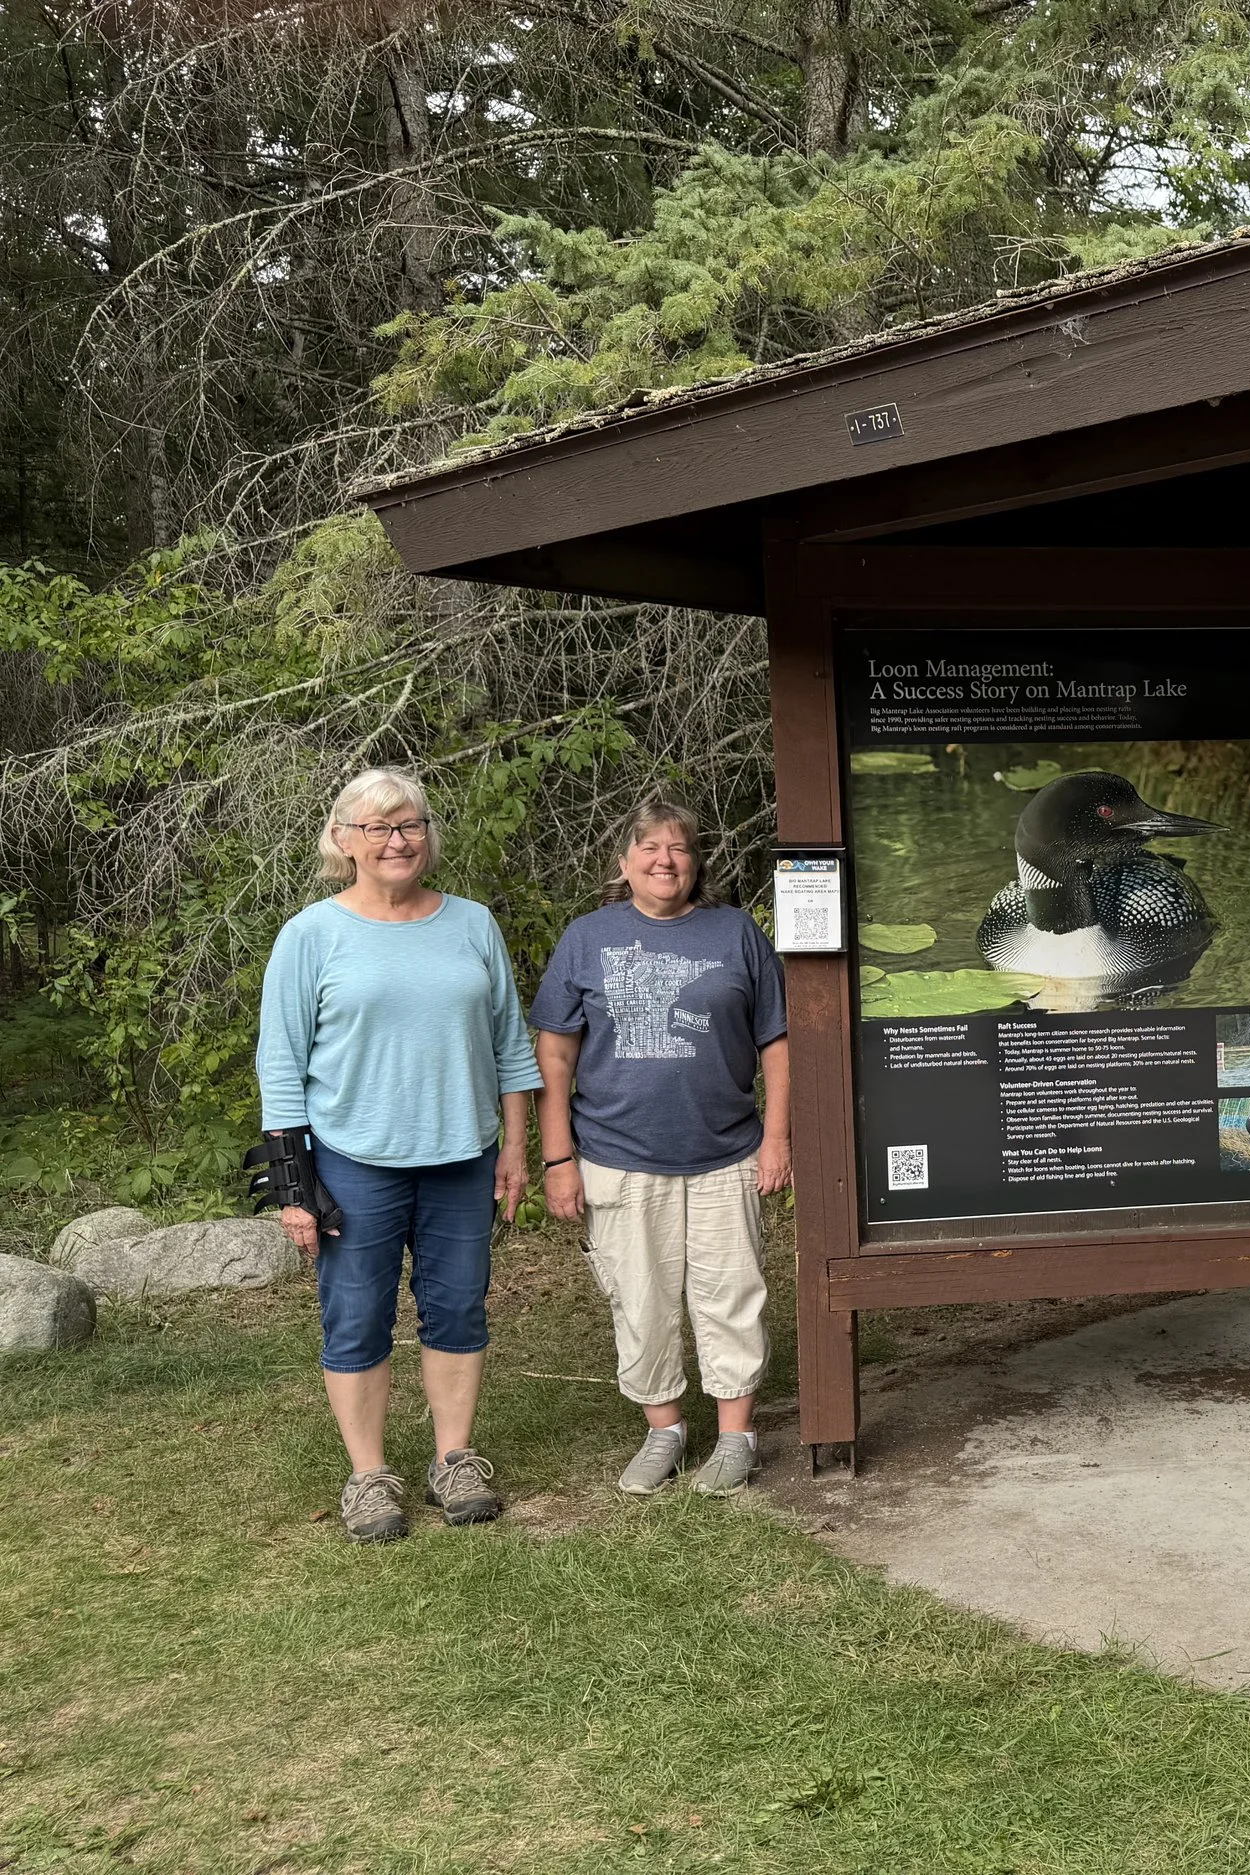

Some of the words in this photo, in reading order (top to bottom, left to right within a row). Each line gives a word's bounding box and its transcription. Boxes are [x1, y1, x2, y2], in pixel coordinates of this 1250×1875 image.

[868, 659, 919, 678] Loon
[925, 659, 1054, 683] Management:
[869, 681, 887, 699] A
[893, 681, 964, 700] Success
[970, 681, 1019, 704] Story
[1025, 685, 1050, 698] on
[1056, 681, 1137, 703] Mantrap
[1143, 678, 1188, 697] Lake
[674, 1010, 709, 1027] MINNESOTA
[883, 1027, 899, 1036] Why
[899, 1026, 918, 1034] Nests
[919, 1025, 955, 1033] Sometimes
[956, 1024, 969, 1032] Fail
[910, 1060, 943, 1068] undisturbed
[1000, 1080, 1054, 1089] Volunteer-Driven
[1054, 1079, 1097, 1087] Conservation
[1066, 1147, 1082, 1155] Help
[1008, 1175, 1029, 1183] Dispose
